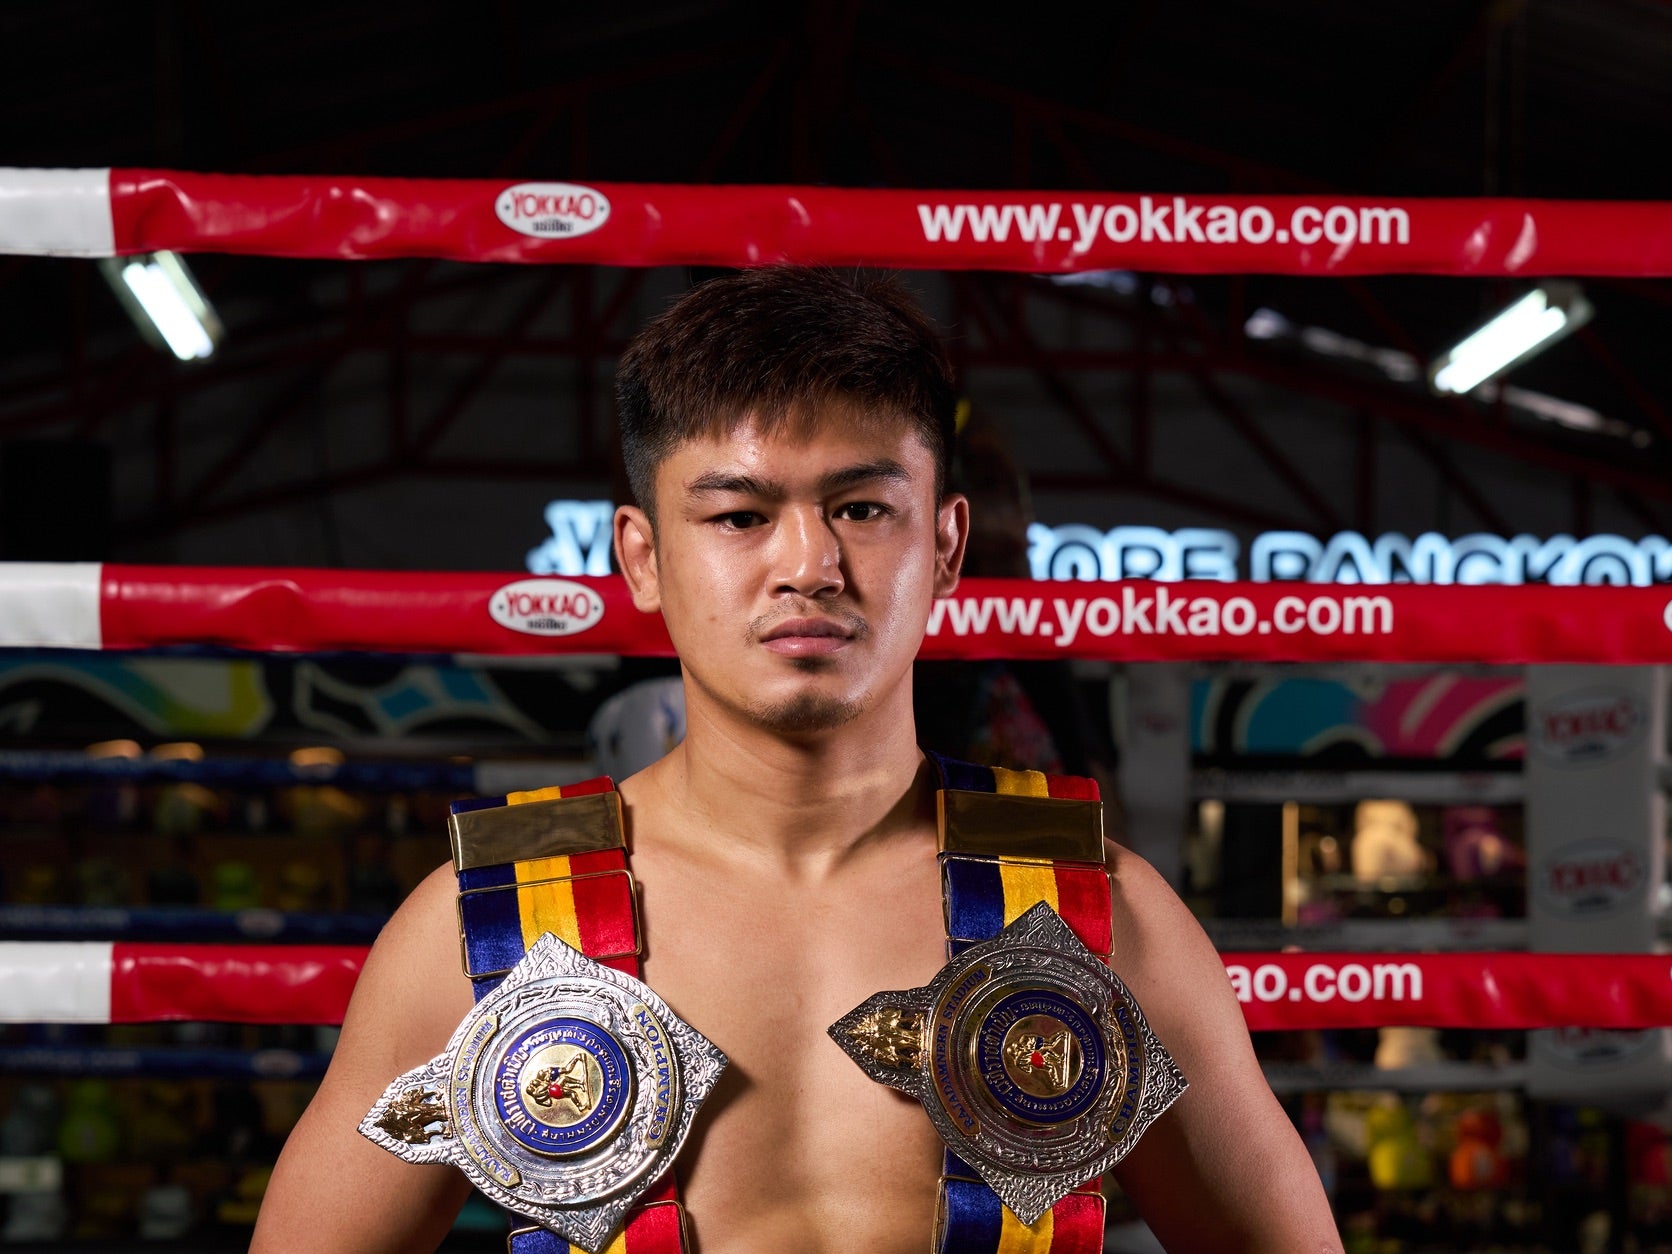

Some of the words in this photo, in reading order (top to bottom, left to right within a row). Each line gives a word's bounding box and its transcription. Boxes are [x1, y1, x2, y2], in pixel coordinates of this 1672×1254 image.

[510, 191, 596, 221] YOKKAO
[918, 197, 1410, 253] www.yokkao.com
[505, 591, 591, 621] YOKKAO
[941, 967, 986, 1021] STADIUM
[456, 1020, 494, 1082] STADIUM
[635, 1009, 672, 1140] CHAMPION
[932, 1022, 976, 1132] RAJADAMNERN
[1111, 1005, 1142, 1133] CHAMPION
[455, 1083, 513, 1184] RAJADAMNERN
